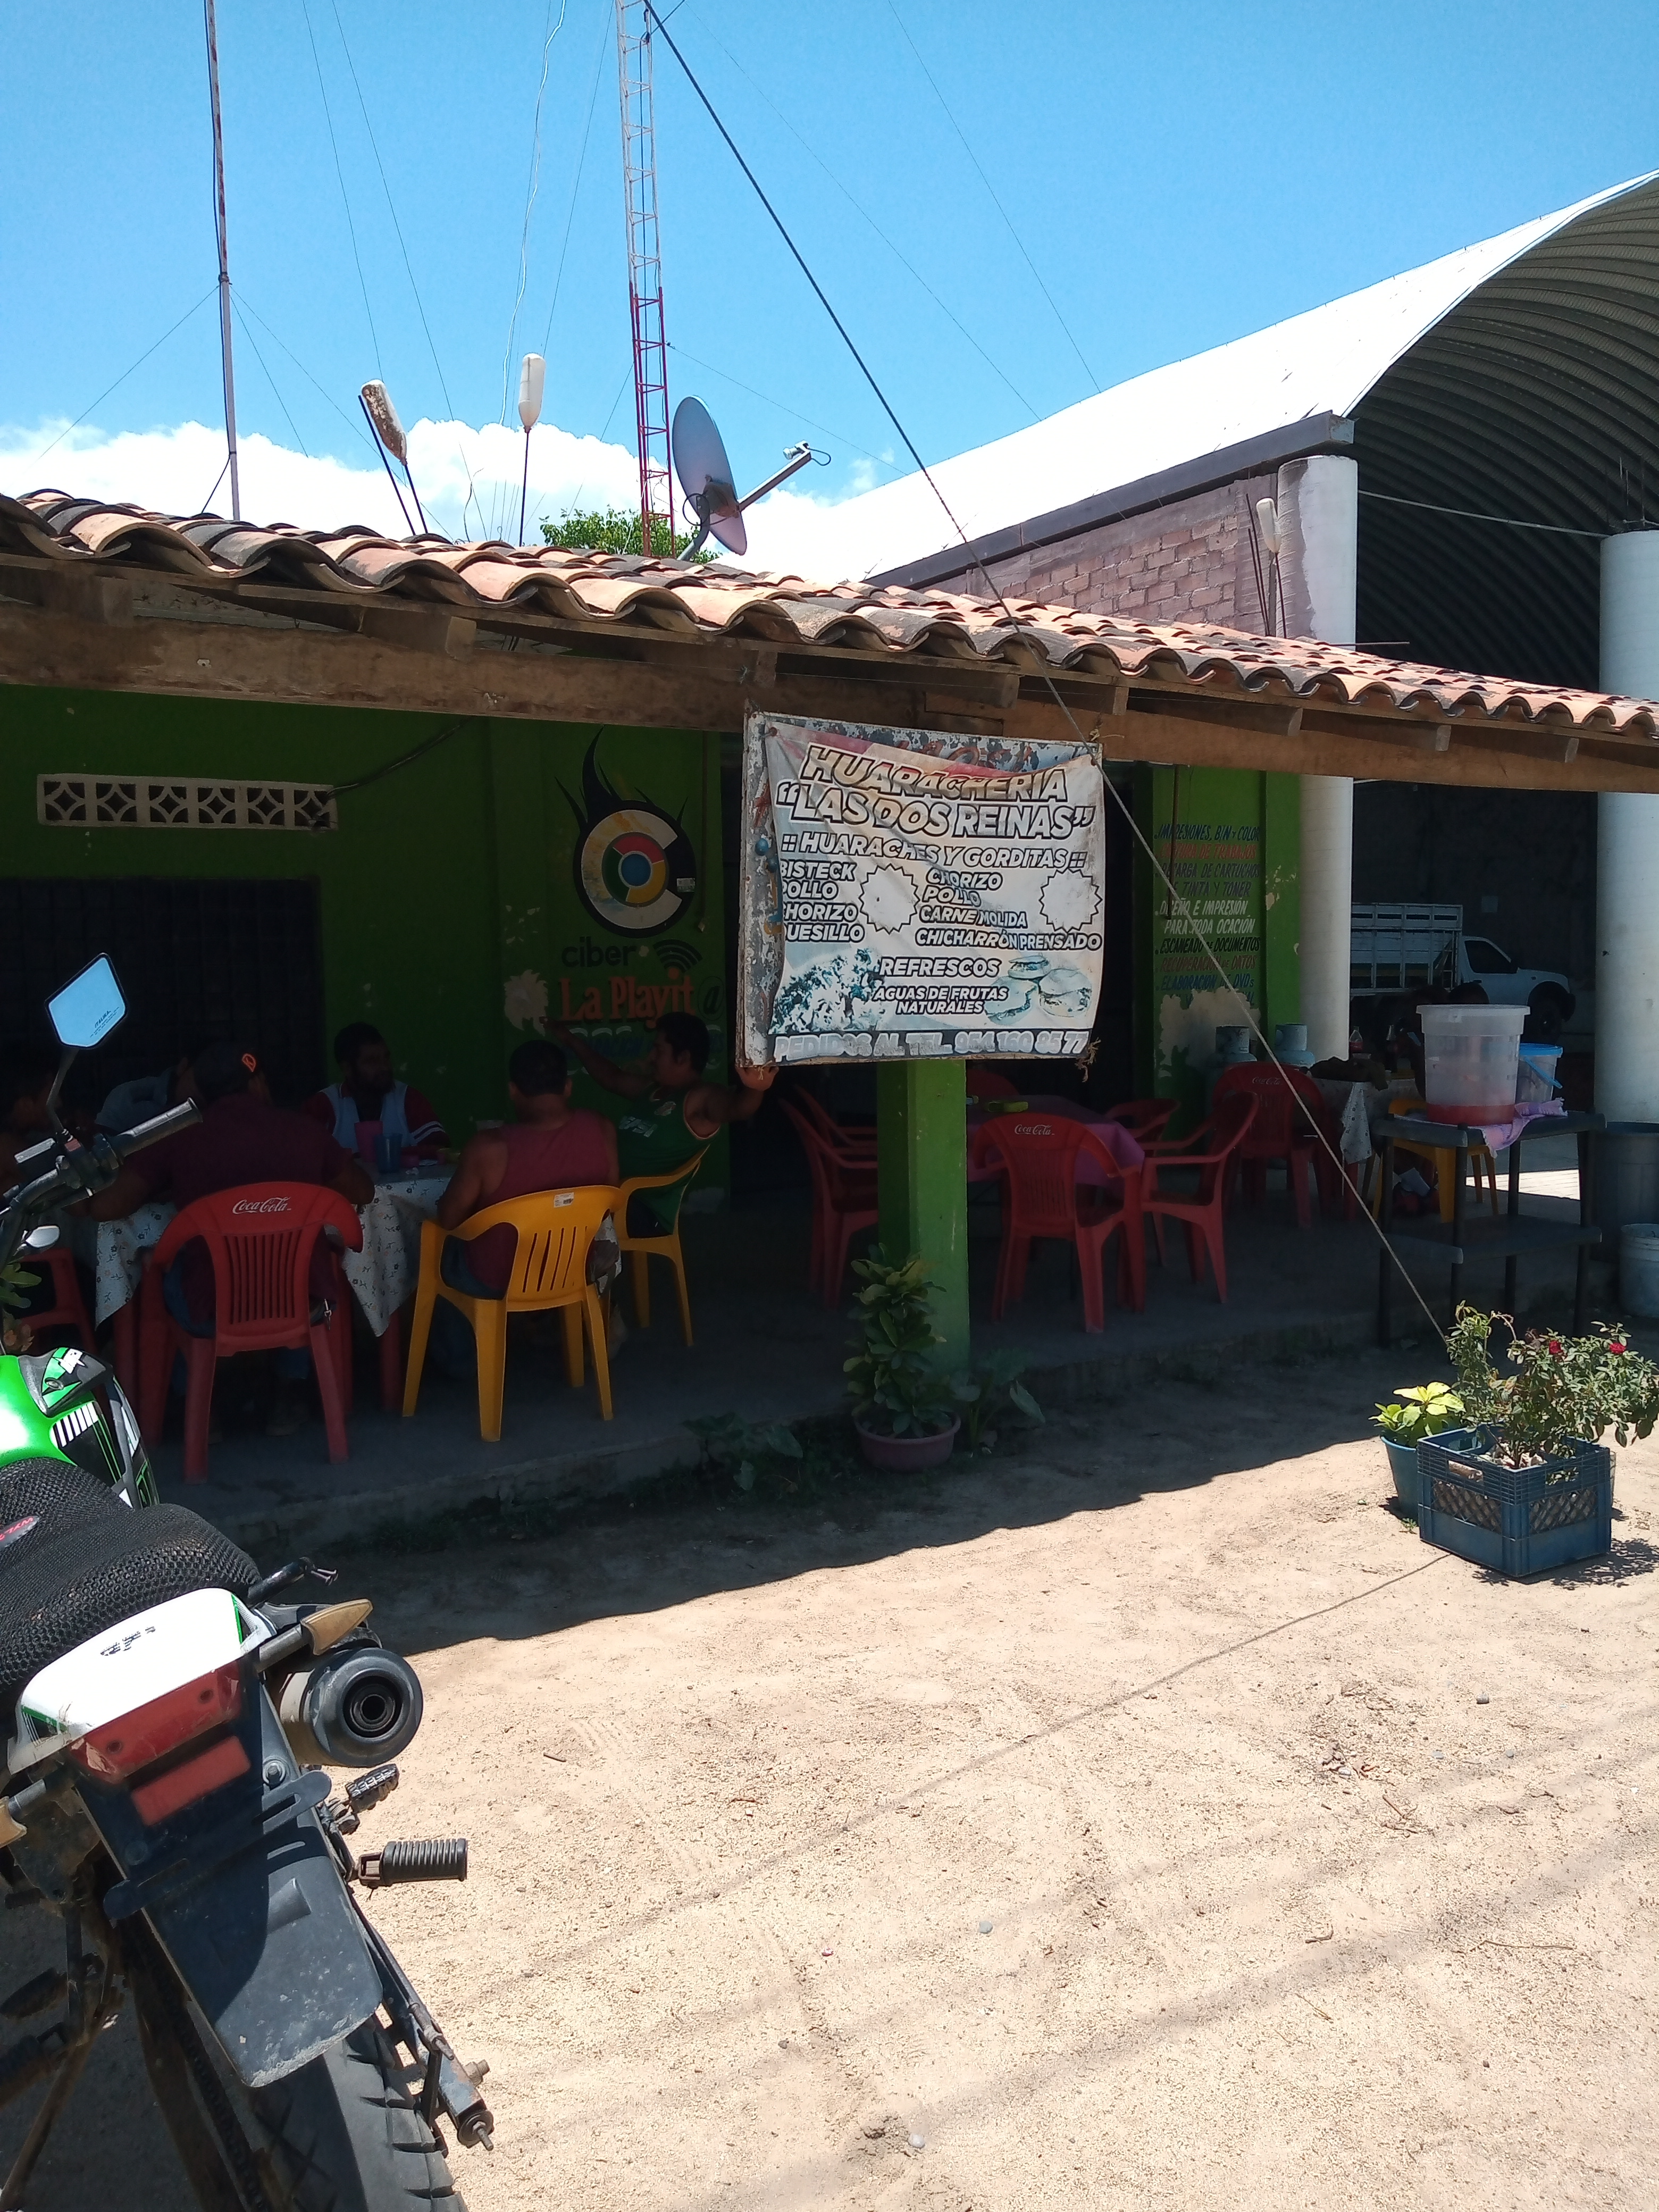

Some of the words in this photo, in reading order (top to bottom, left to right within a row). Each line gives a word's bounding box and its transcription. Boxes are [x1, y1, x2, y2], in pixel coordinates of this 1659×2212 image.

[873, 798, 952, 837] DOS
[799, 831, 941, 864] HUARACHES
[944, 846, 966, 866] Y
[962, 847, 1068, 868] GORDITAS
[1199, 843, 1211, 859] DE
[1213, 843, 1257, 860] TRABAJOS
[780, 859, 857, 881] BISTECK
[925, 867, 1003, 891] CHORIZO
[1200, 862, 1213, 878] DE
[922, 885, 981, 907] POLLO
[1182, 881, 1210, 896] TINTA
[1213, 881, 1220, 896] Y
[1223, 881, 1252, 897] TONER
[783, 901, 859, 921] HORIZO
[919, 904, 979, 925] CARNE
[977, 910, 1028, 928] MOLIDA
[1193, 900, 1201, 916] E
[1202, 898, 1249, 916] IMPRESIÓN
[784, 923, 865, 943] UESILLO
[1164, 918, 1188, 934] PARA
[1217, 915, 1255, 934] OCACIÓN
[915, 928, 1018, 949] CHICHARRÓN
[1018, 933, 1102, 950] PRENSADO
[1213, 936, 1260, 952] DOCUMENTOS
[562, 936, 636, 967] ciber
[879, 957, 1002, 977] REFRESCOS
[1230, 955, 1256, 970] DATOS
[559, 977, 604, 1024] La
[872, 986, 927, 1001] AGUAS
[927, 986, 950, 1001] DE
[950, 986, 1009, 1001] FRUTAS
[895, 1000, 985, 1015] NATURALES
[774, 1033, 873, 1062] PEDIDOS
[873, 1033, 904, 1056] AL
[954, 1030, 995, 1054] 954
[996, 1030, 1034, 1053] 160
[1062, 1030, 1089, 1054] 77
[1015, 1124, 1052, 1135] Coca-Cola
[232, 1196, 291, 1214] Coca-Cola
